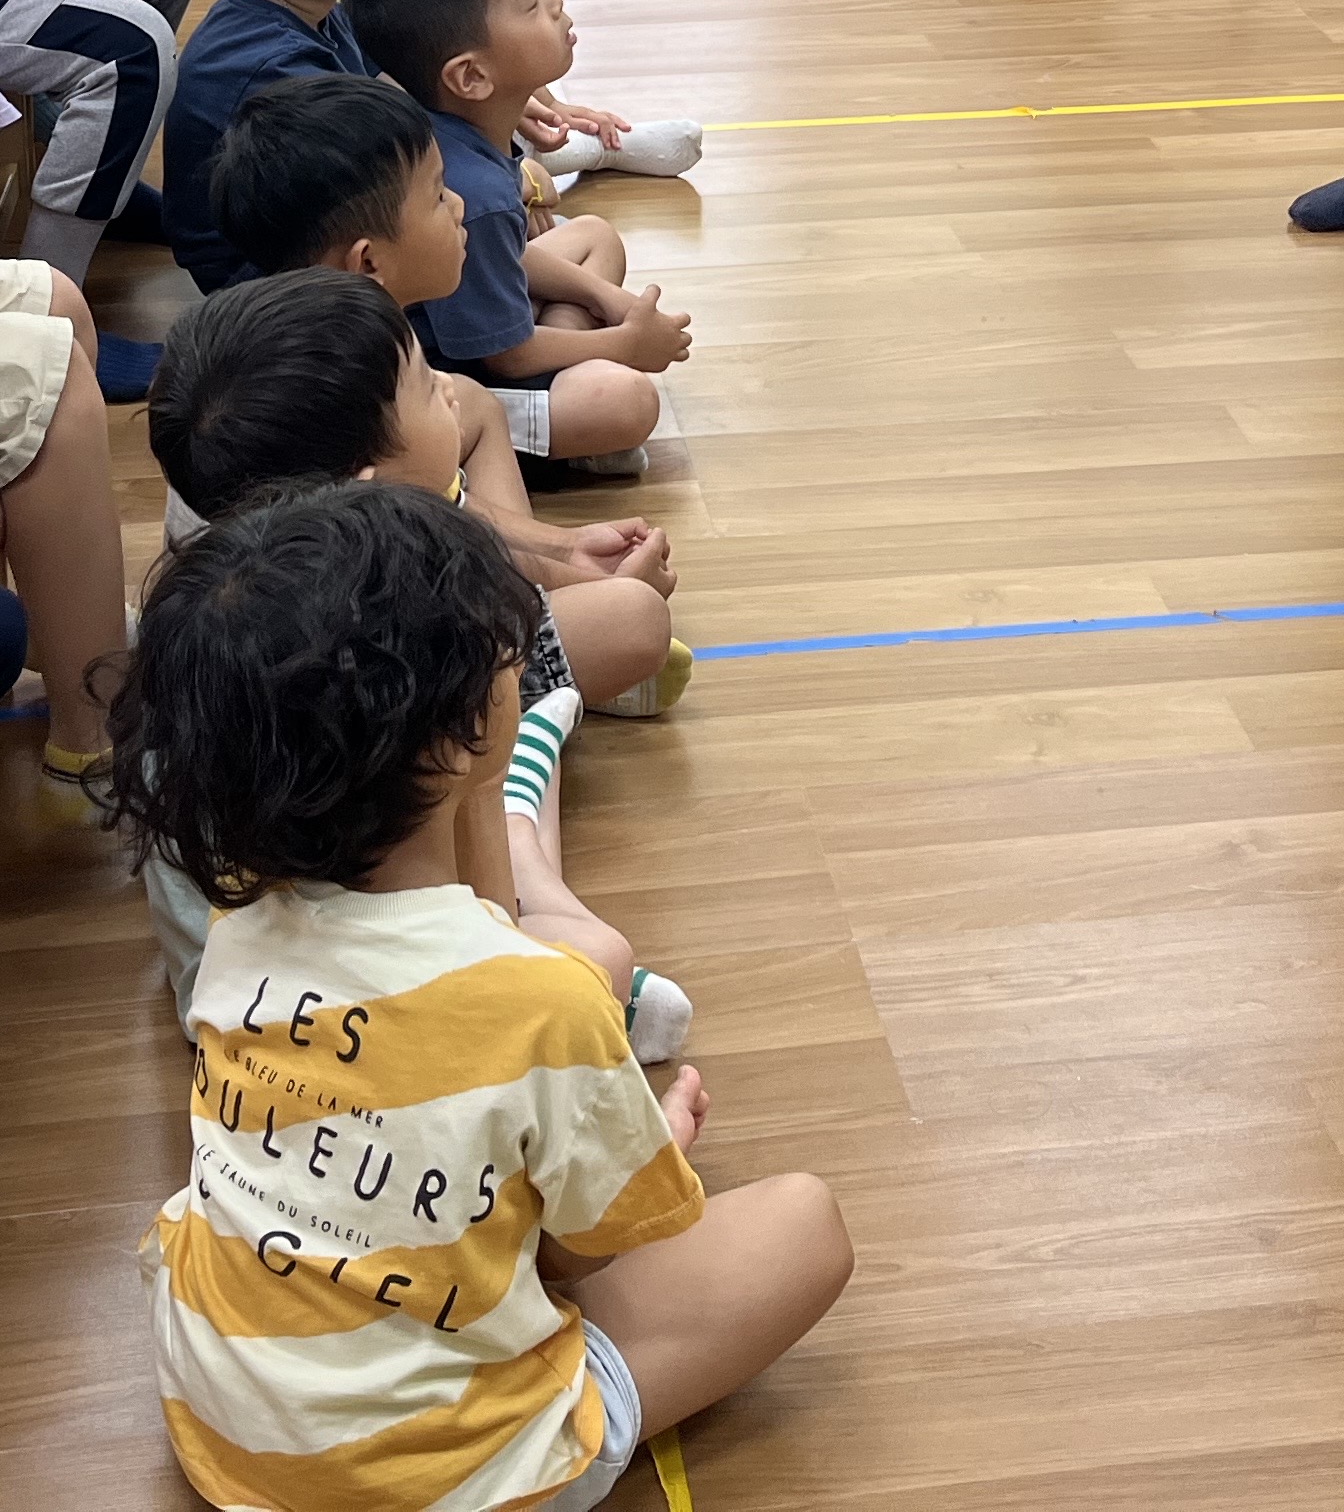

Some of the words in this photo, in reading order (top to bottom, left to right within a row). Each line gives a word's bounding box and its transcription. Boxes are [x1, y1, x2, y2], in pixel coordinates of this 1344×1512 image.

[243, 976, 369, 1063] LES
[195, 1048, 495, 1223] OULEURS
[245, 1055, 278, 1085] BLEU
[286, 1078, 306, 1098] DE
[317, 1092, 337, 1110] LA
[350, 1105, 384, 1129] MER
[196, 1143, 215, 1161] LE
[219, 1162, 265, 1202] JAUNE
[277, 1200, 298, 1218] DU
[310, 1214, 372, 1249] SOLEIL
